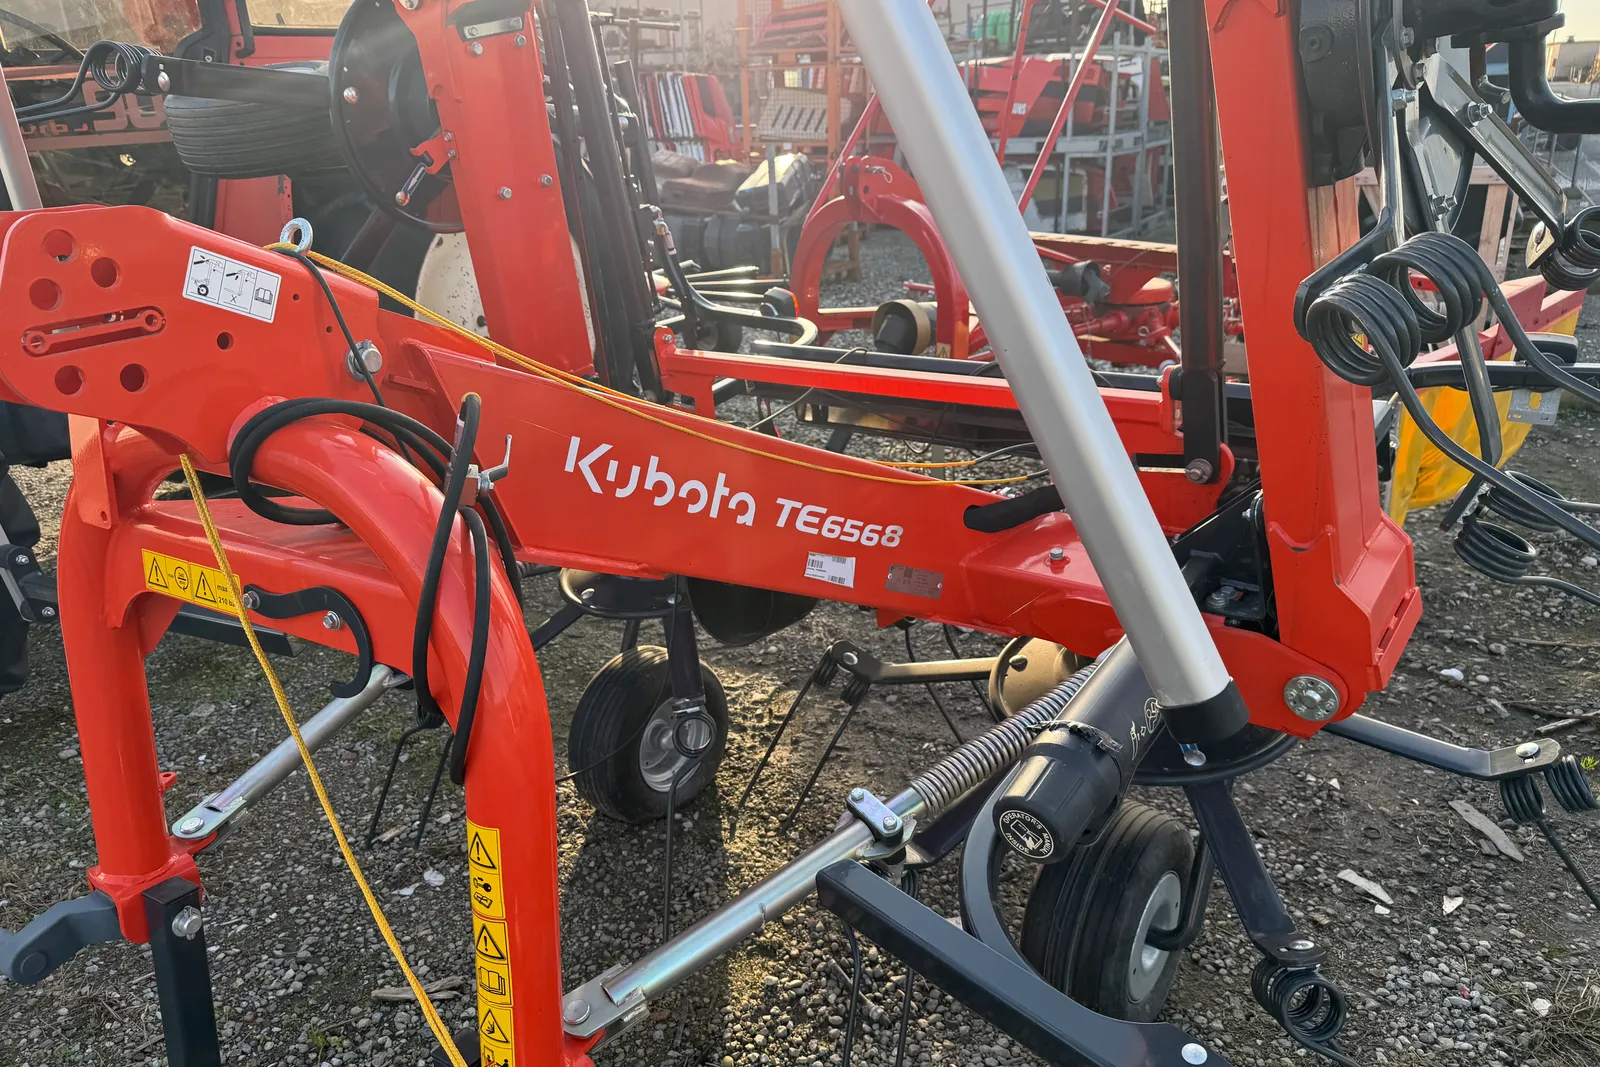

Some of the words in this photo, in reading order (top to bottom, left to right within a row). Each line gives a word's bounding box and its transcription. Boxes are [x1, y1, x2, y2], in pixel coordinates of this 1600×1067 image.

[564, 435, 756, 527] Kubota
[775, 497, 904, 548] TE6568
[218, 596, 228, 606] 210
[1002, 812, 1043, 830] OPERATOR'S
[1039, 832, 1051, 855] MANUAL
[1005, 832, 1030, 854] INSIDE
